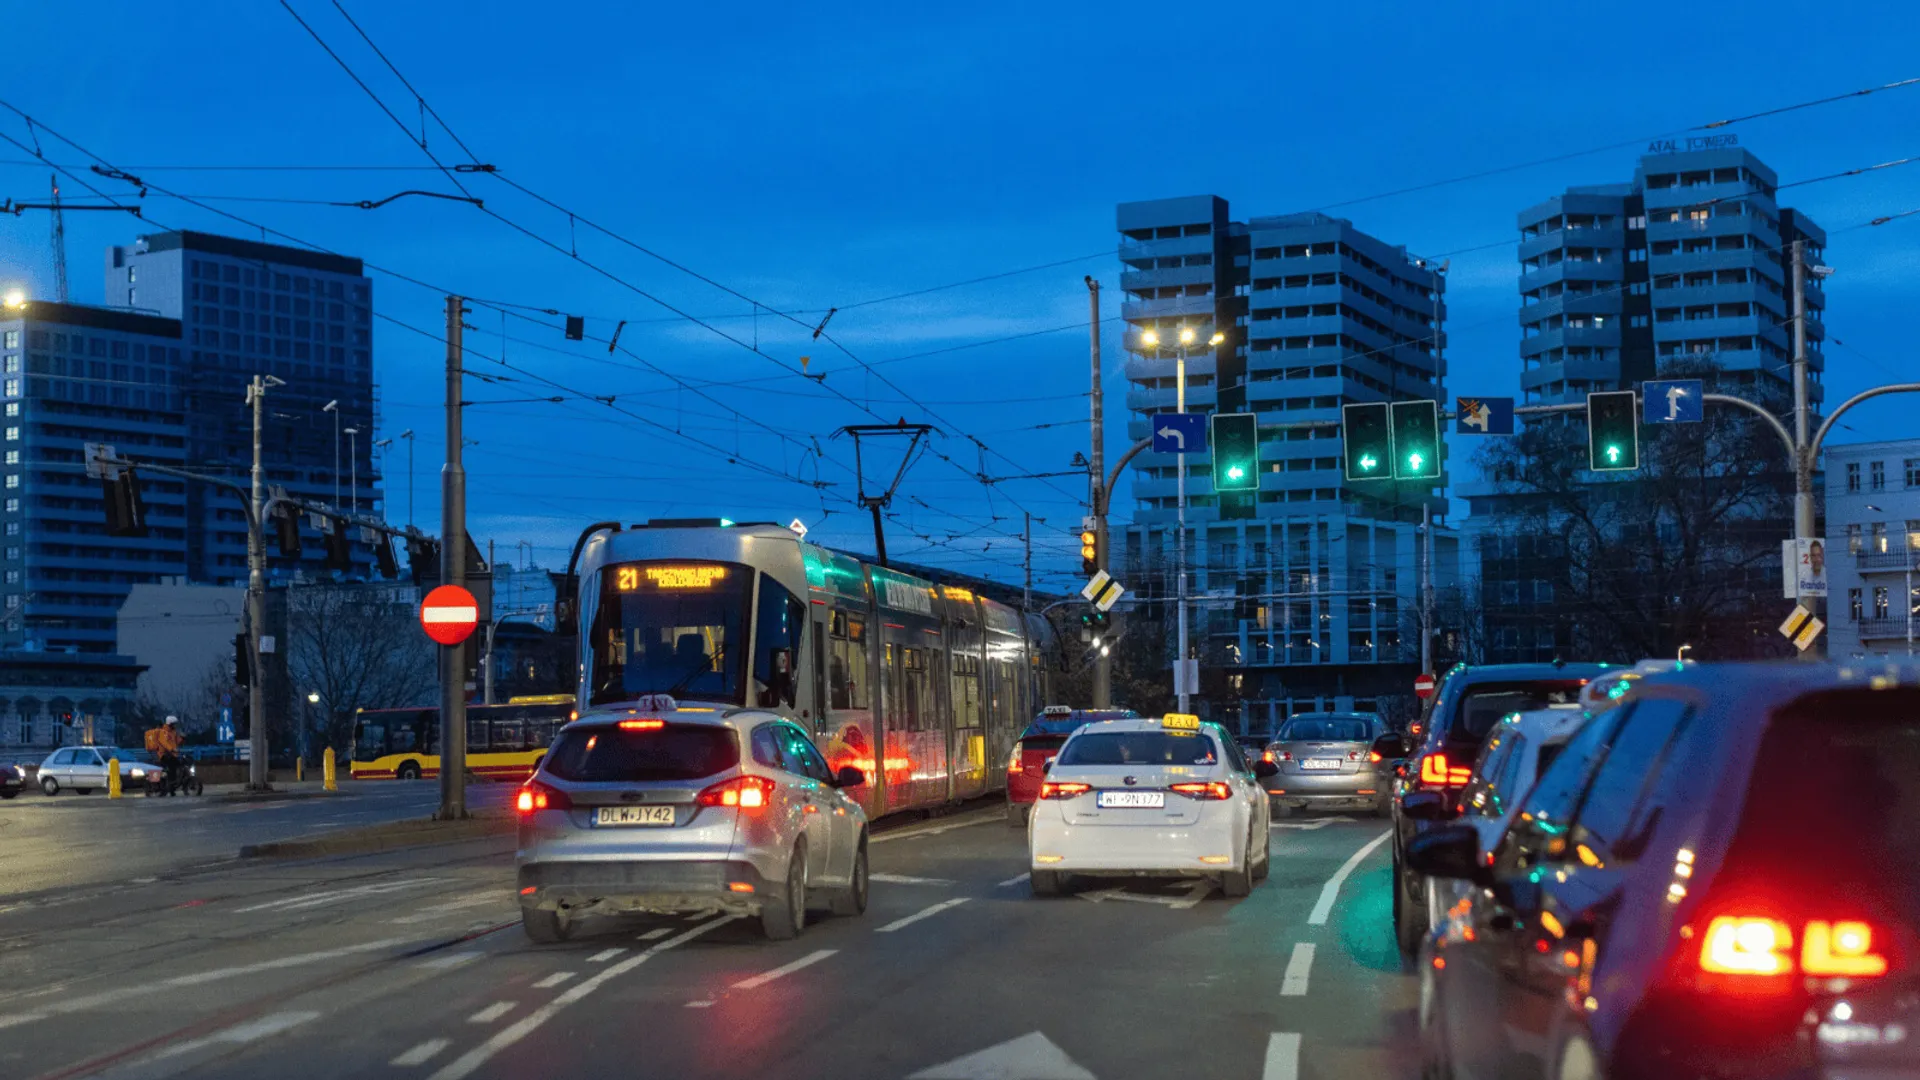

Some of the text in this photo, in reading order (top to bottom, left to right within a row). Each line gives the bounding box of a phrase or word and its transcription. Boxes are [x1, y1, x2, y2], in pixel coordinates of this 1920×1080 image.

[1648, 133, 1738, 153] ATAL TOWERS
[619, 567, 637, 588] 21
[642, 697, 670, 709] TAXI
[1047, 706, 1067, 715] TAXI
[1167, 716, 1194, 727] TAXI
